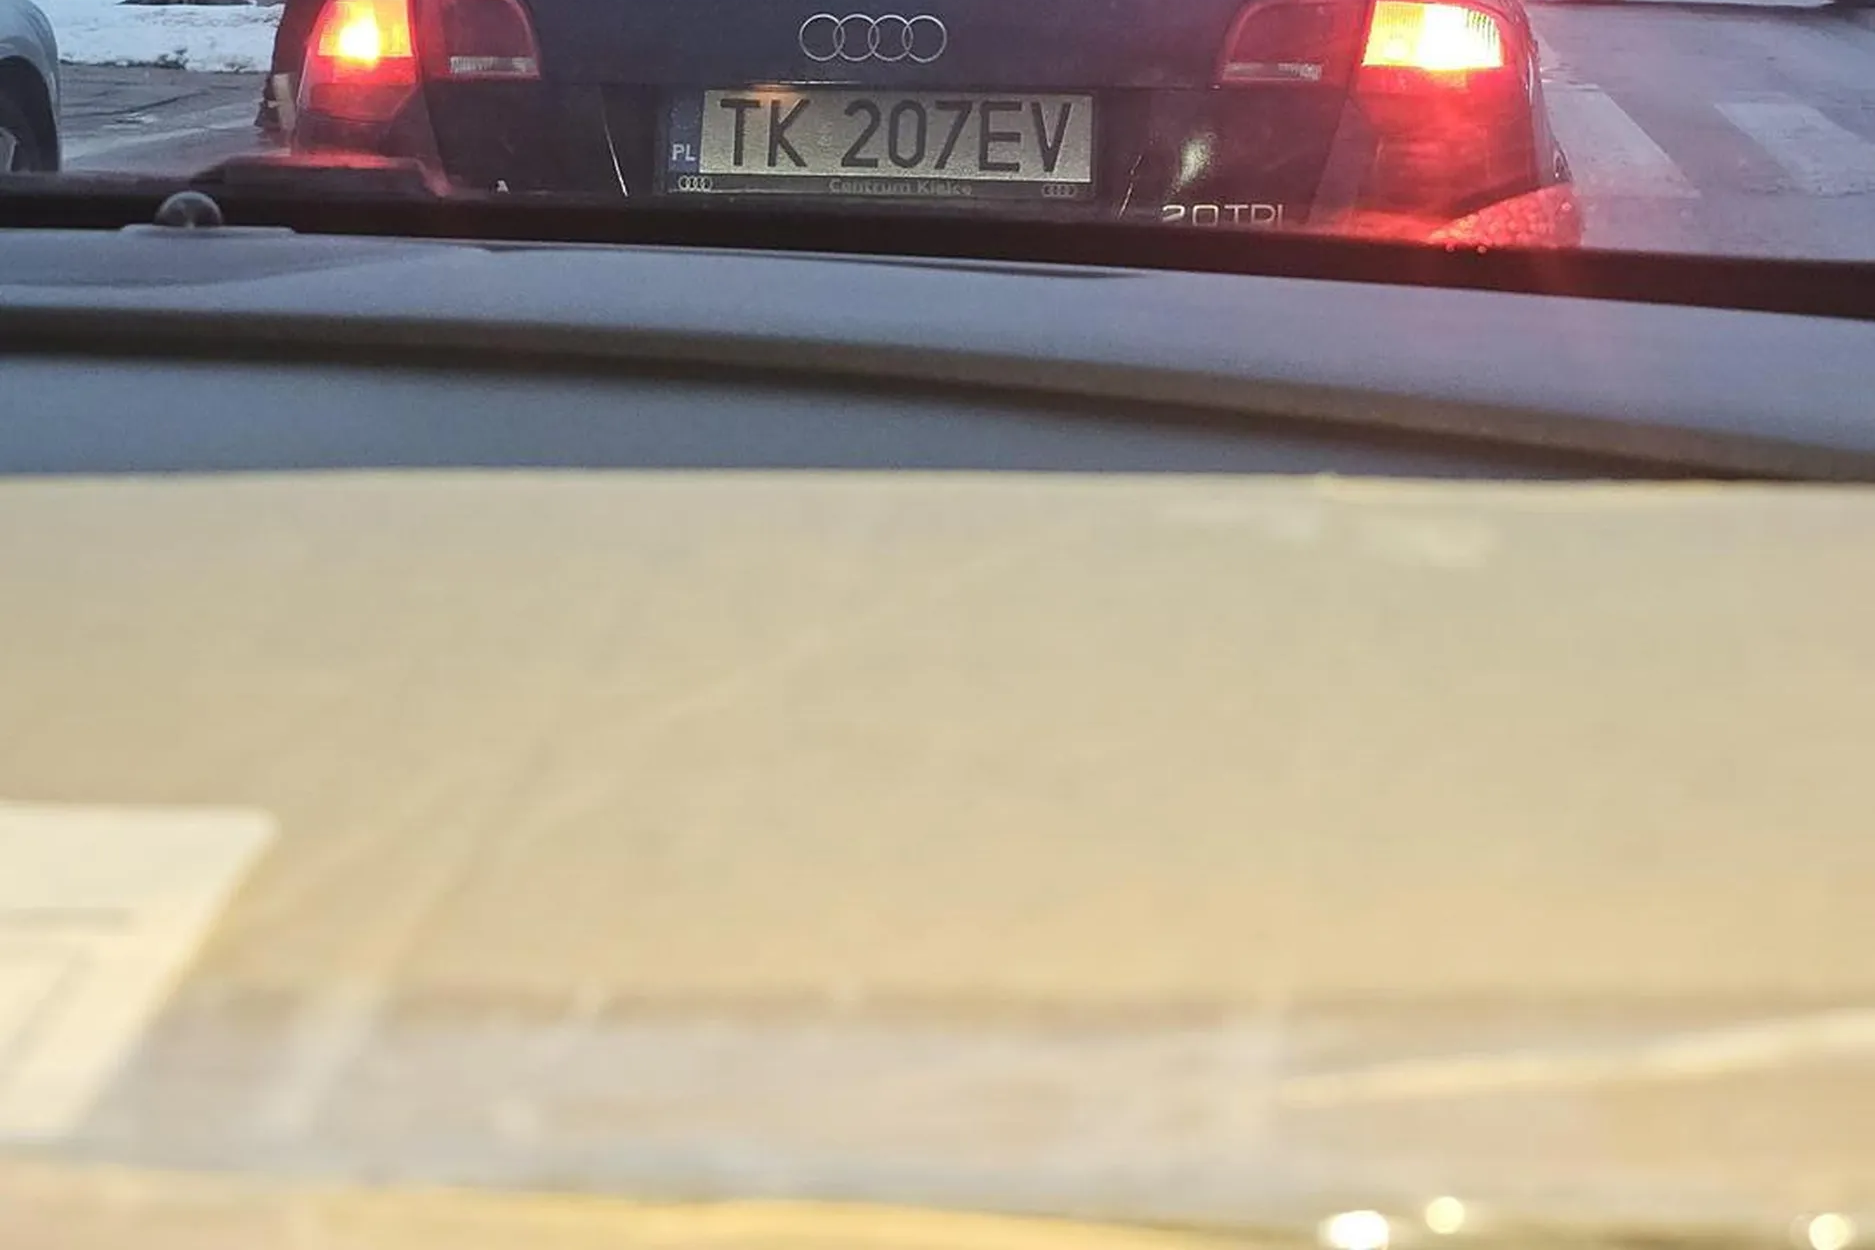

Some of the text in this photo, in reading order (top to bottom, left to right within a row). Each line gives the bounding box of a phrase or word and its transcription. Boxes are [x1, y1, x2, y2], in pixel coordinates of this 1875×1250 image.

[720, 98, 1072, 173] TK 207EV
[672, 144, 697, 162] PL
[829, 178, 974, 196] Centrum Kielce
